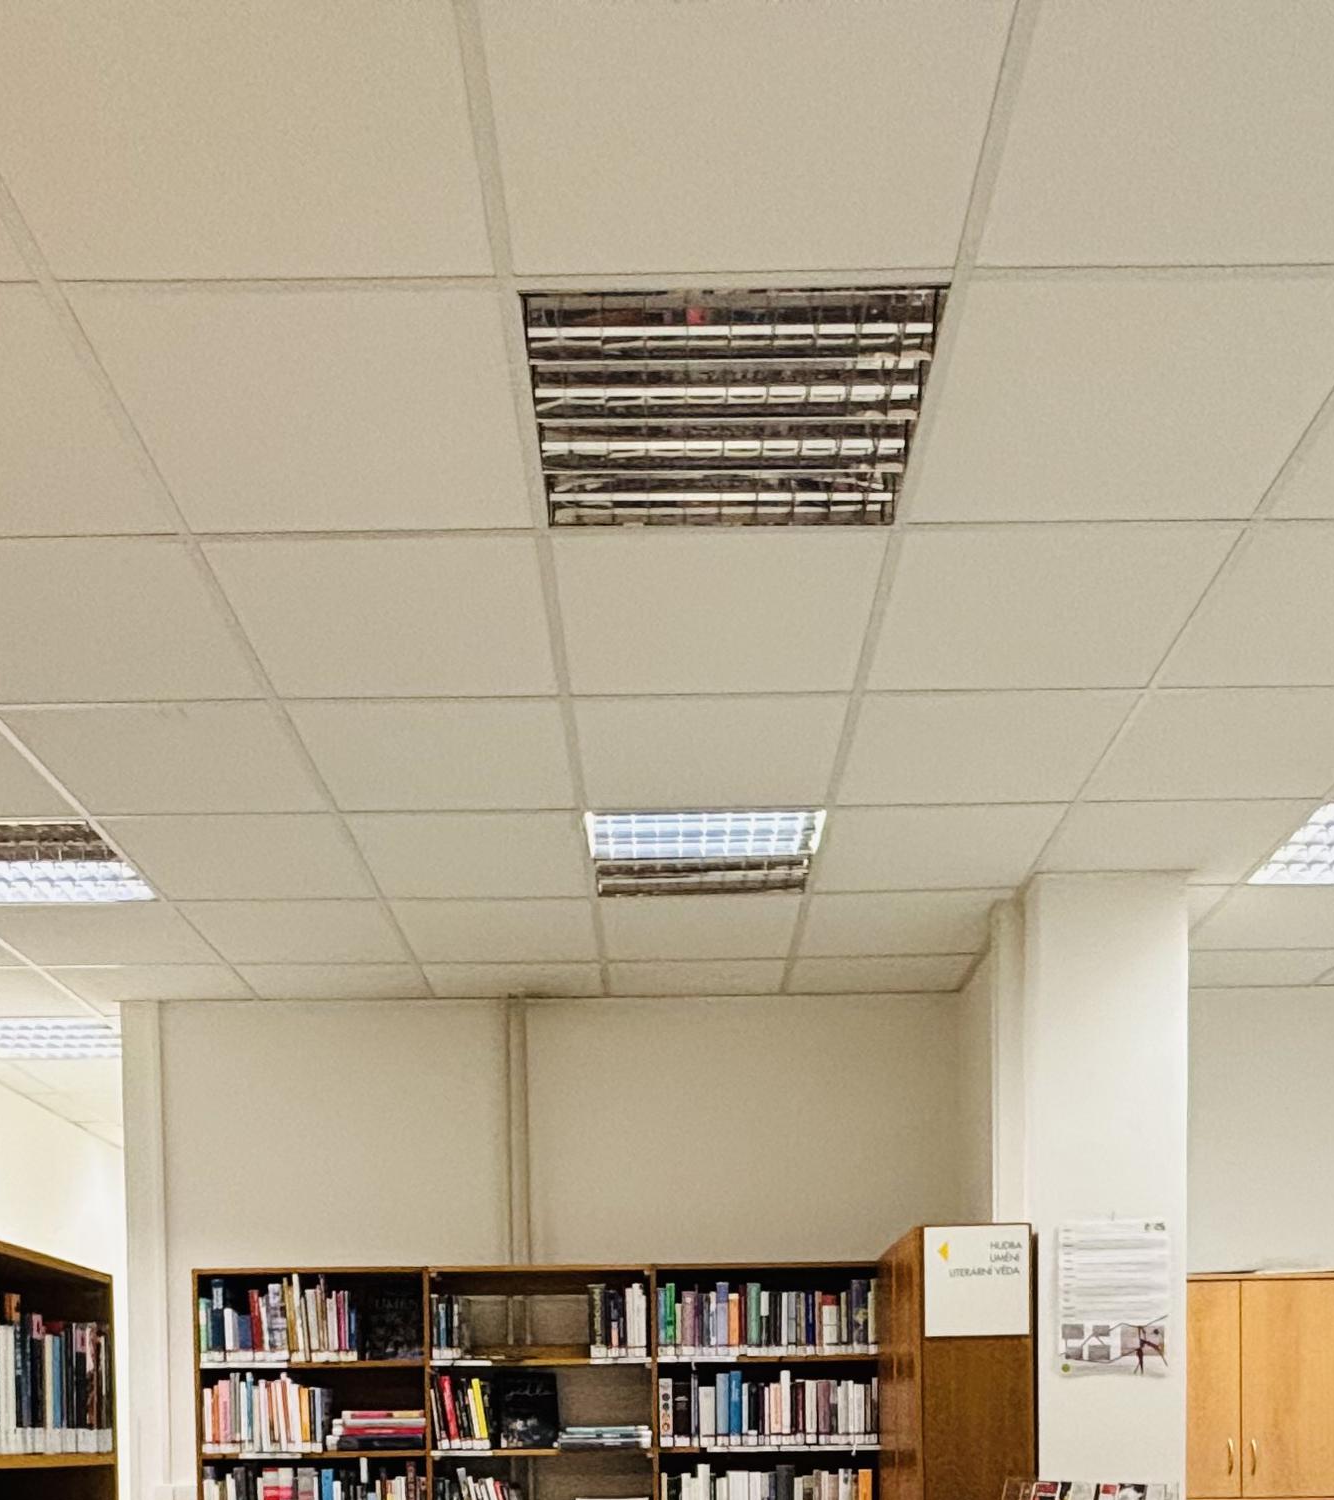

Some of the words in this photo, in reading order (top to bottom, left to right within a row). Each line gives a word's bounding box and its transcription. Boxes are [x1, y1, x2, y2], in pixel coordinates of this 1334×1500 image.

[990, 1241, 1022, 1250] HUDBA
[989, 1251, 1020, 1263] UMĚNÍ
[948, 1266, 993, 1278] LITERÁRNÍ
[994, 1265, 1020, 1276] VĚDA
